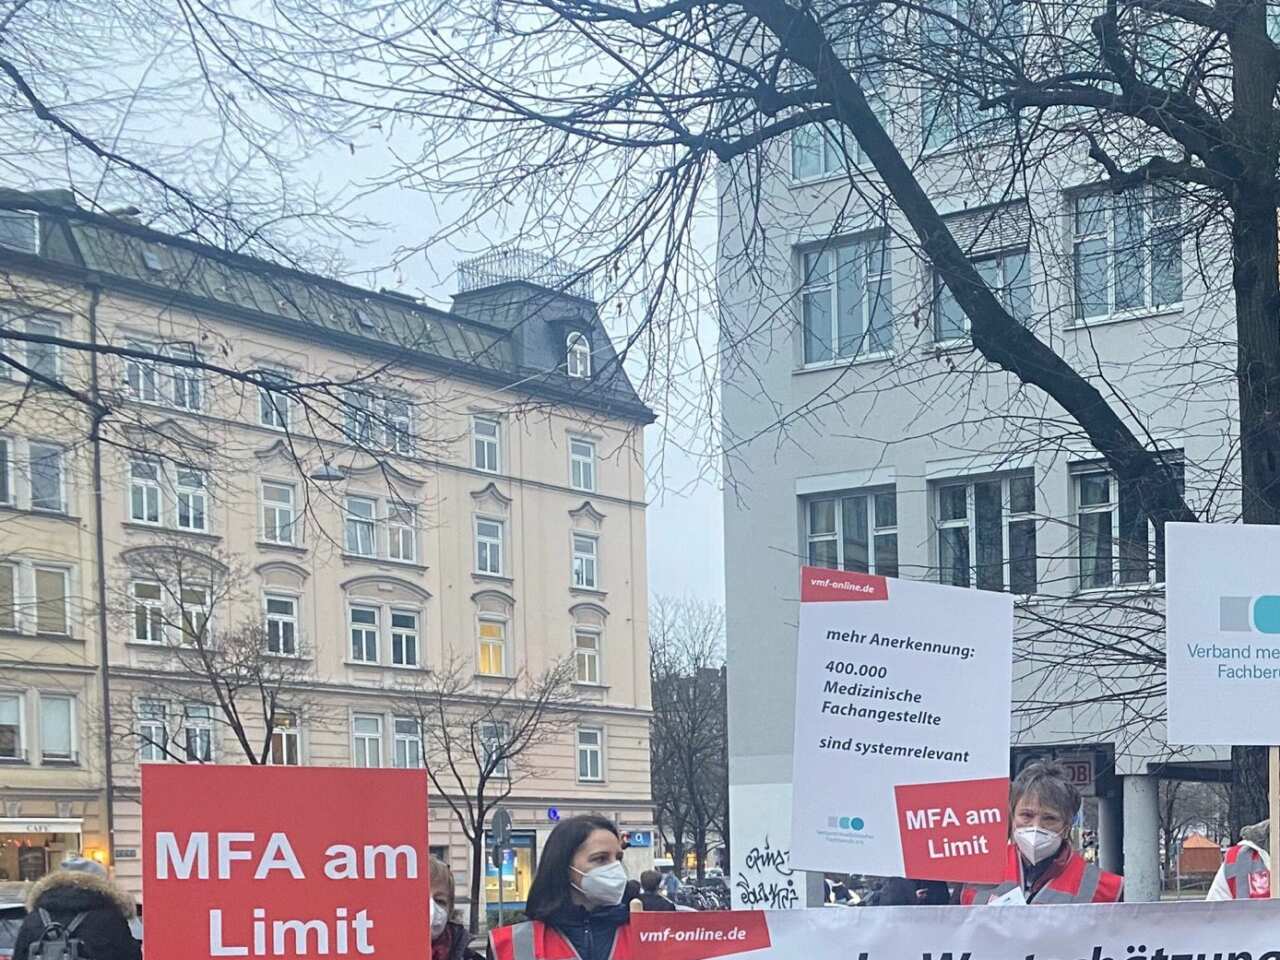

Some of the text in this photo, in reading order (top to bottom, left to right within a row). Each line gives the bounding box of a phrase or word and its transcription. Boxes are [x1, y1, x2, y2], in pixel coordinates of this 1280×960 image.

[810, 578, 875, 594] vmf-online.de
[826, 629, 975, 659] mehr Anerkennung:
[1187, 644, 1250, 659] Verband
[825, 661, 887, 679] 400.000
[824, 681, 922, 703] Medizinische
[821, 700, 941, 726] Fachangestellte
[819, 736, 970, 763] sind systemrelevant
[906, 807, 1001, 830] MFA am
[156, 832, 418, 880] MFA am
[928, 836, 989, 859] Limit
[209, 908, 375, 956] Limit
[639, 927, 747, 943] vmf-online.de
